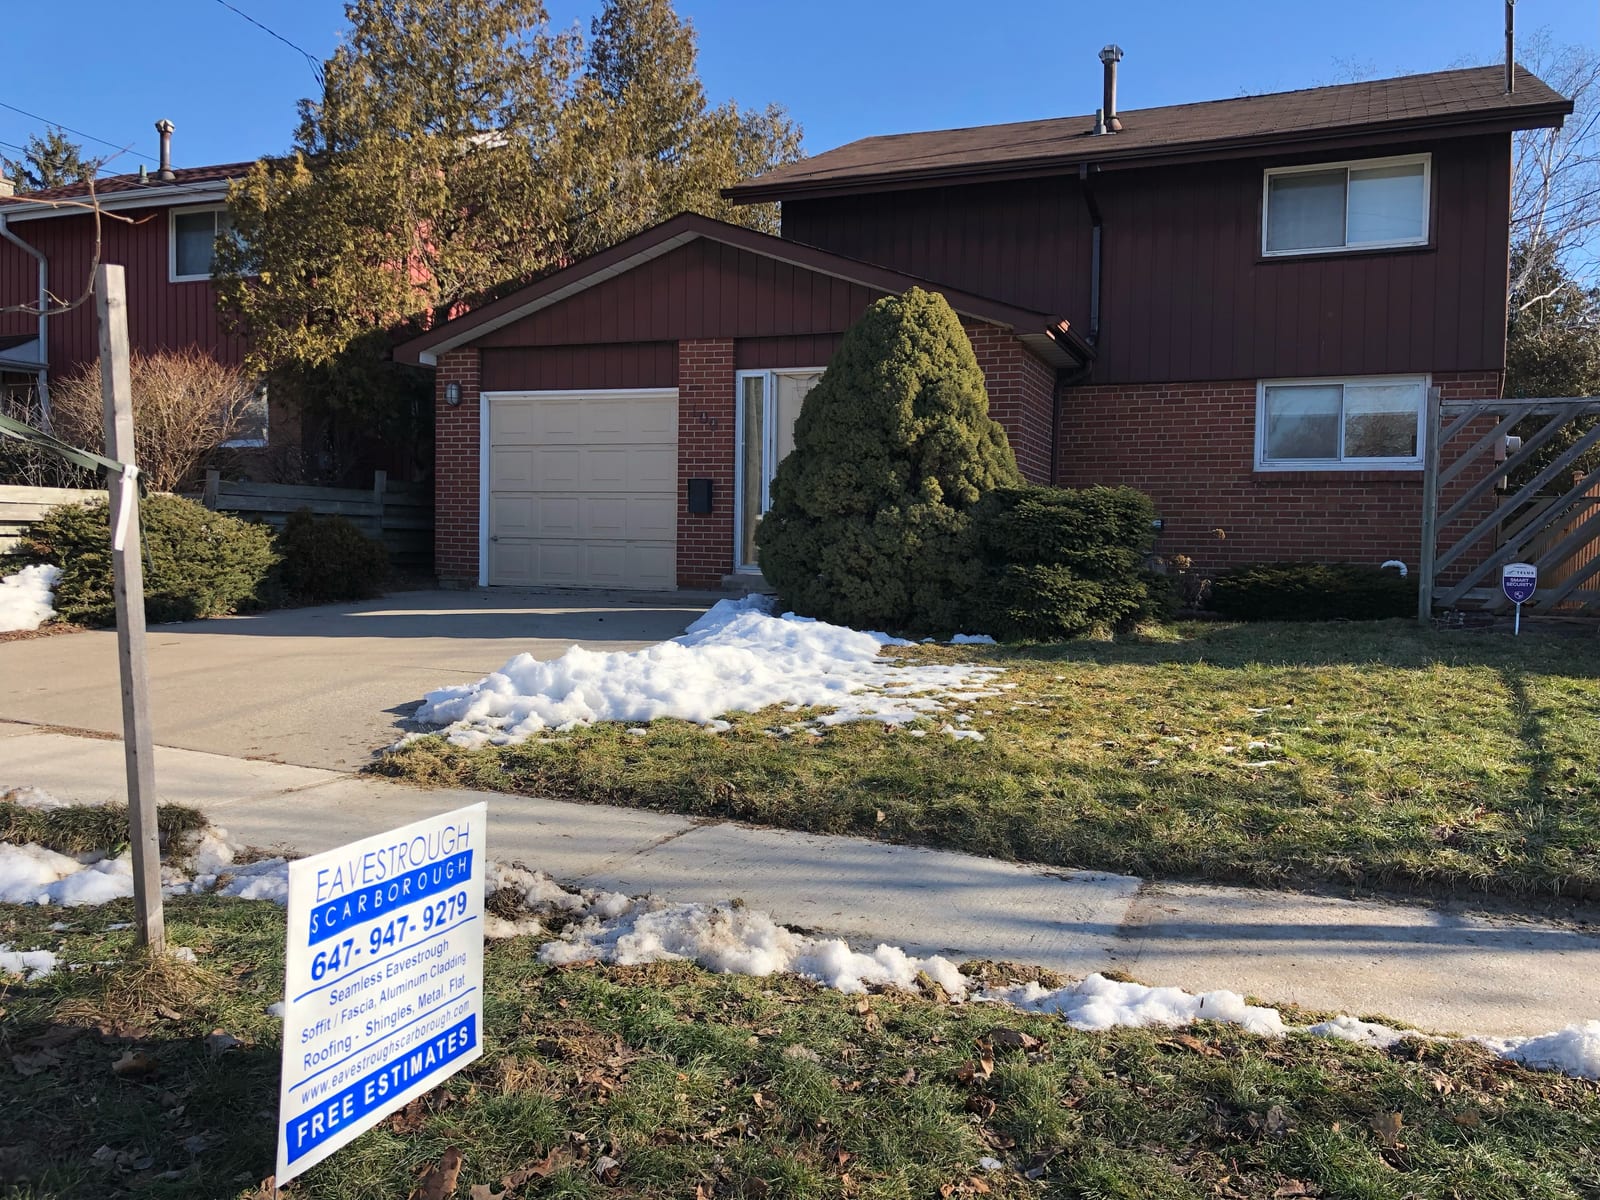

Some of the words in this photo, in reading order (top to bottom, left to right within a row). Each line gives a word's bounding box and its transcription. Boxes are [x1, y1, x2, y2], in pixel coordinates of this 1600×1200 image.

[311, 856, 467, 934] SCARBOROUGH
[316, 822, 470, 903] EAVESTROUGH
[301, 1016, 331, 1044] Soffit
[341, 999, 377, 1022] Fascia,
[379, 972, 428, 1002] Aluminum
[430, 951, 467, 978] Cladding
[329, 973, 383, 1005] Seamless
[386, 939, 449, 978] Eavestrough
[301, 1000, 470, 1105] www.eavestroughscarborough.com
[303, 1035, 352, 1071] Roofing
[365, 1003, 415, 1037] Shingles,
[449, 974, 466, 993] Flat
[297, 1093, 354, 1148] FREE
[364, 1025, 469, 1105] ESTIMATES
